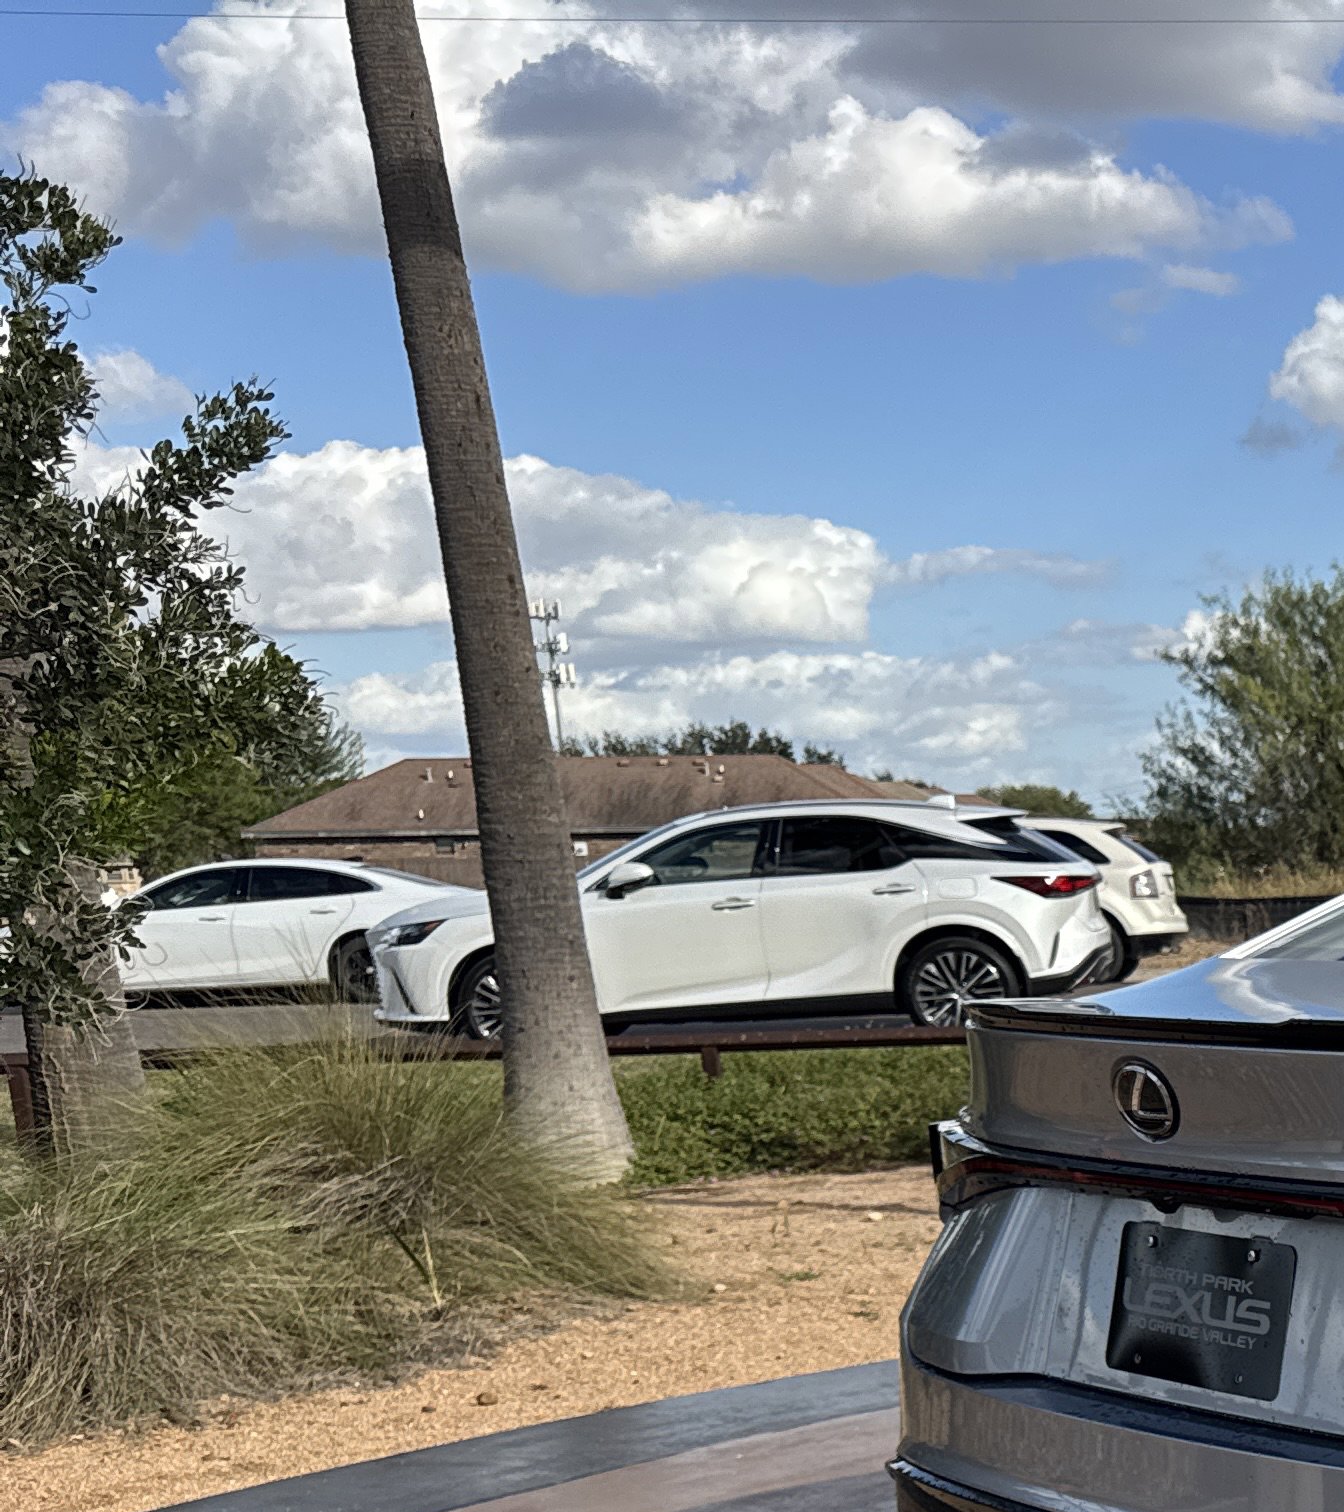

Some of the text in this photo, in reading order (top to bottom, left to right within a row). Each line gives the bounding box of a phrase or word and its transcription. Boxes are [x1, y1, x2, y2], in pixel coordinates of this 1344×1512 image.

[1139, 1262, 1255, 1296] NORTH PARK
[1122, 1276, 1272, 1336] LEXUS
[1127, 1314, 1258, 1351] RIO GRANDE VALLEY
